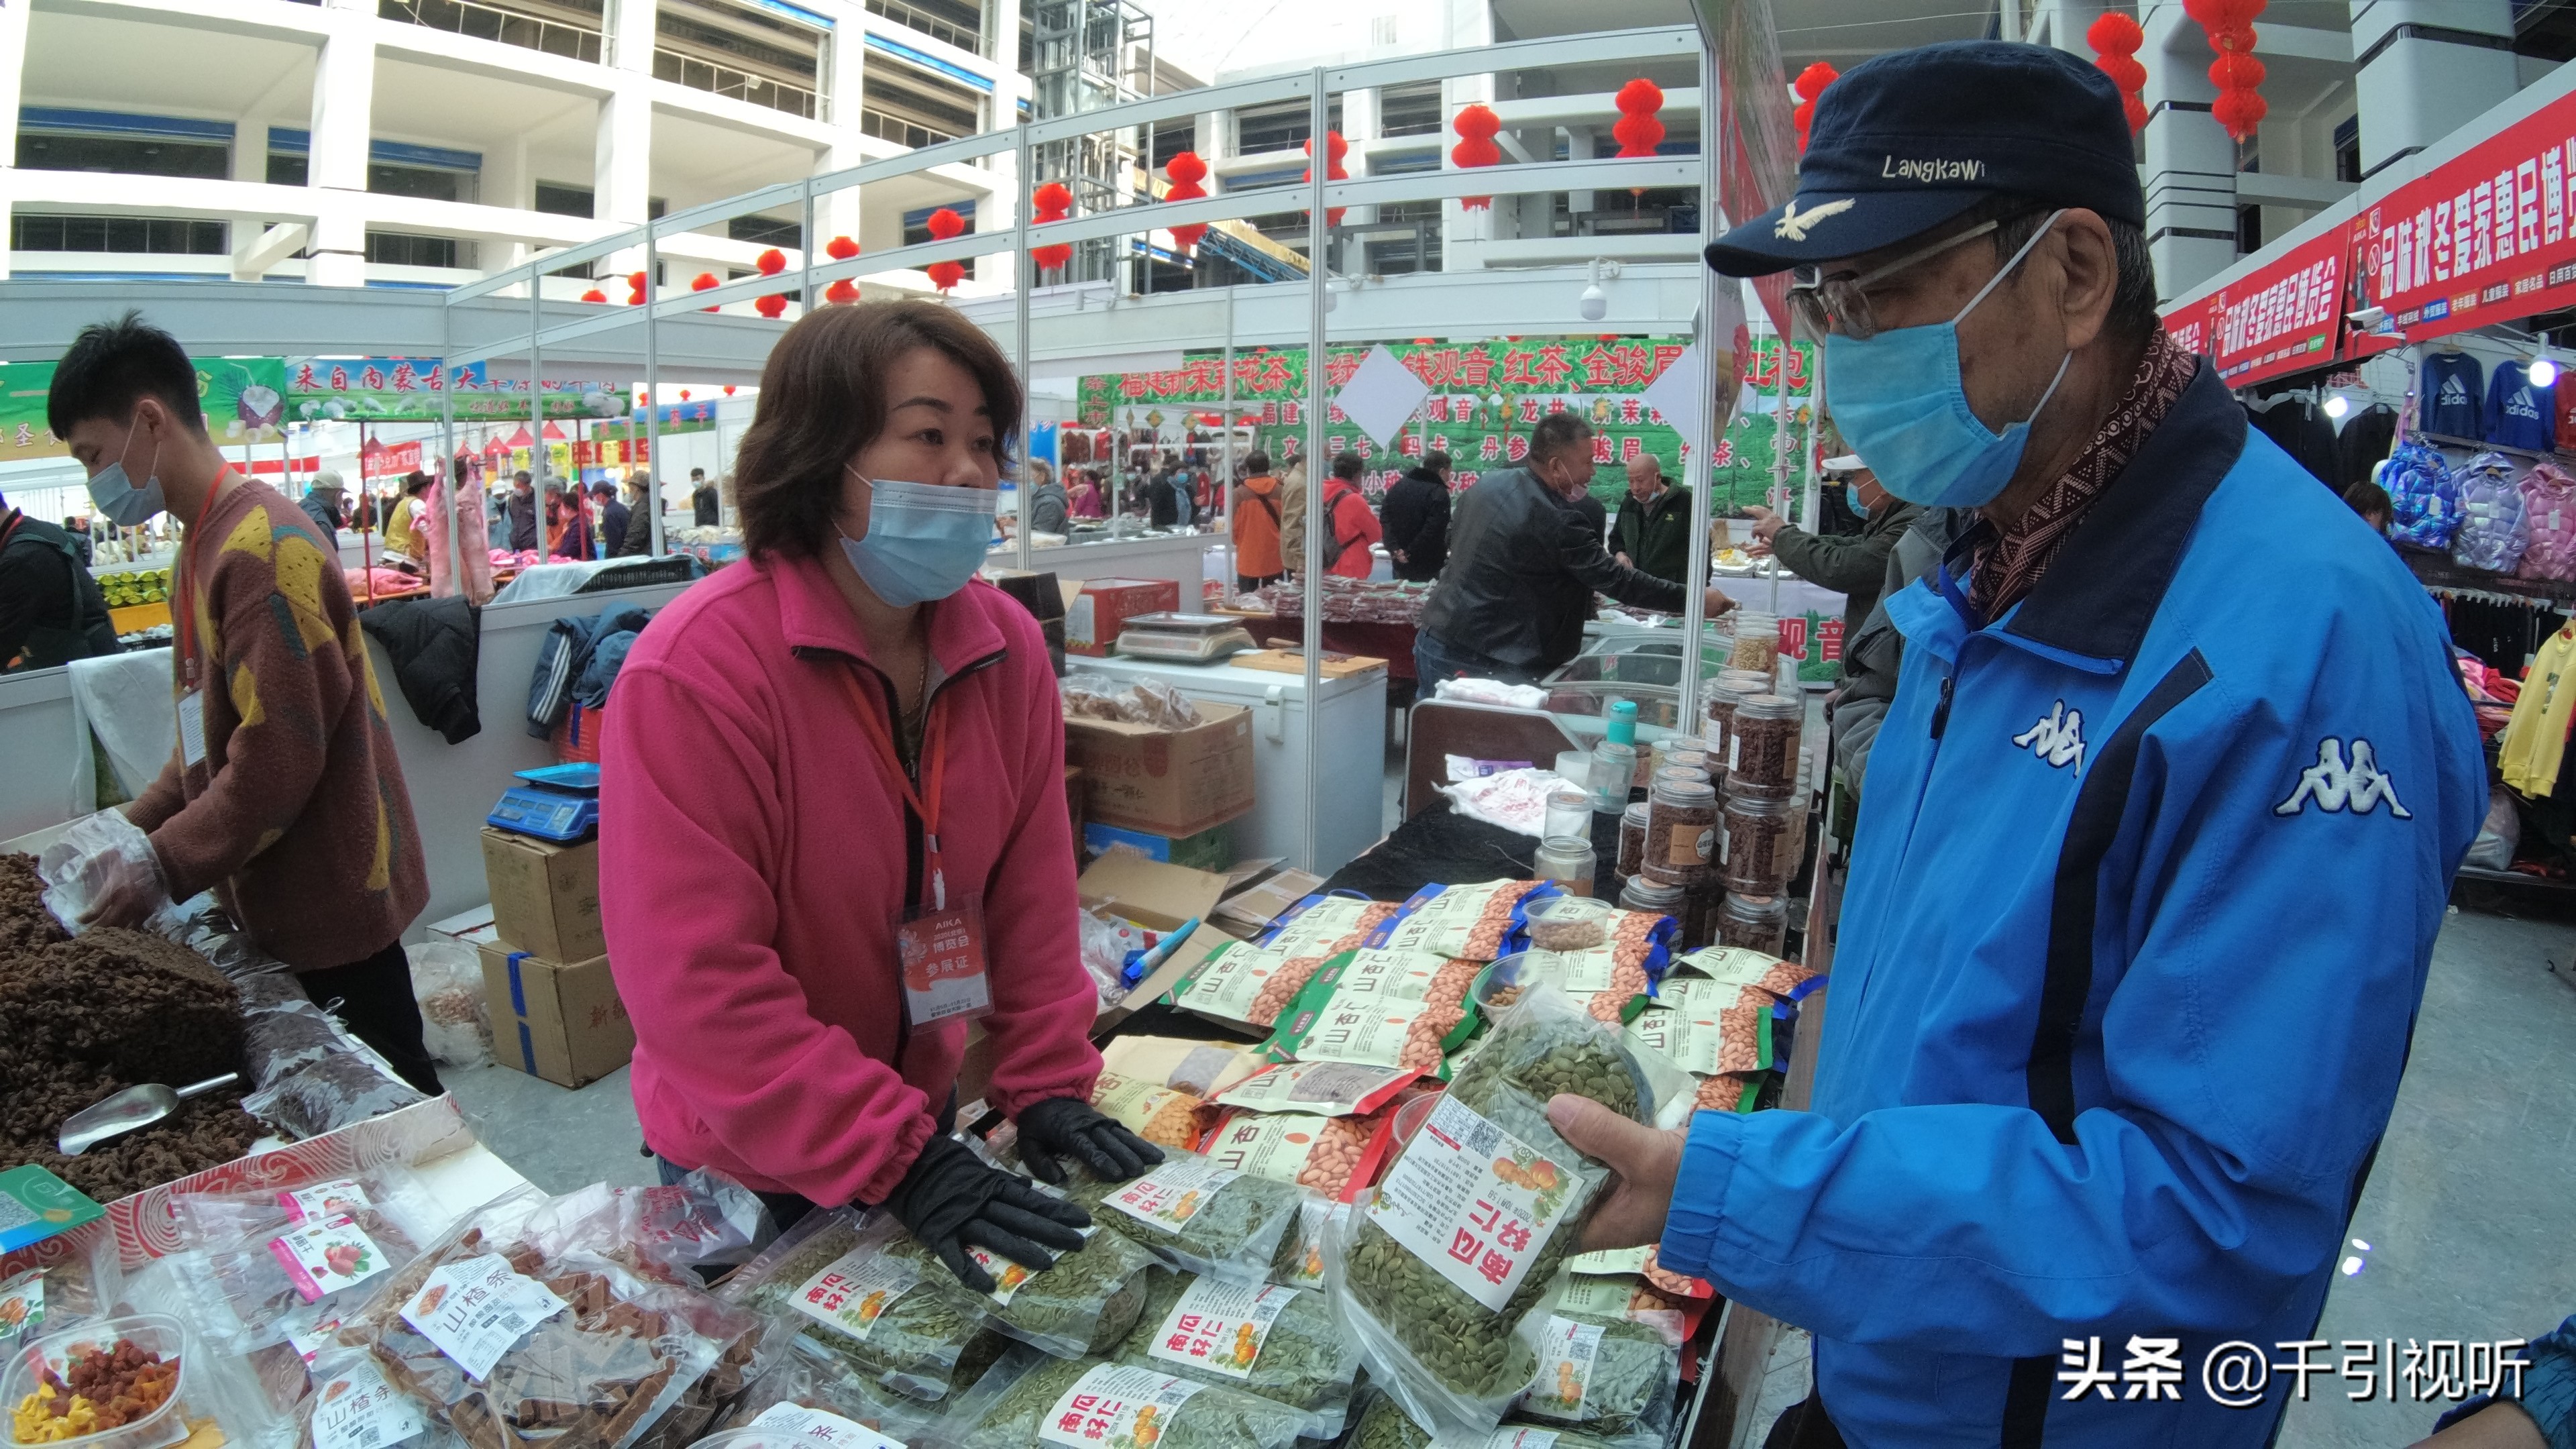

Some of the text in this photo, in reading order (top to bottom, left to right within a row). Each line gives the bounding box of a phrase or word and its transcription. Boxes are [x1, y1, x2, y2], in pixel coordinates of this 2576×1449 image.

[926, 955, 969, 977] 参展证
[1468, 1198, 1533, 1253] 籽仁
[1447, 1226, 1514, 1286] 南瓜
[443, 1269, 512, 1334] 山楂条
